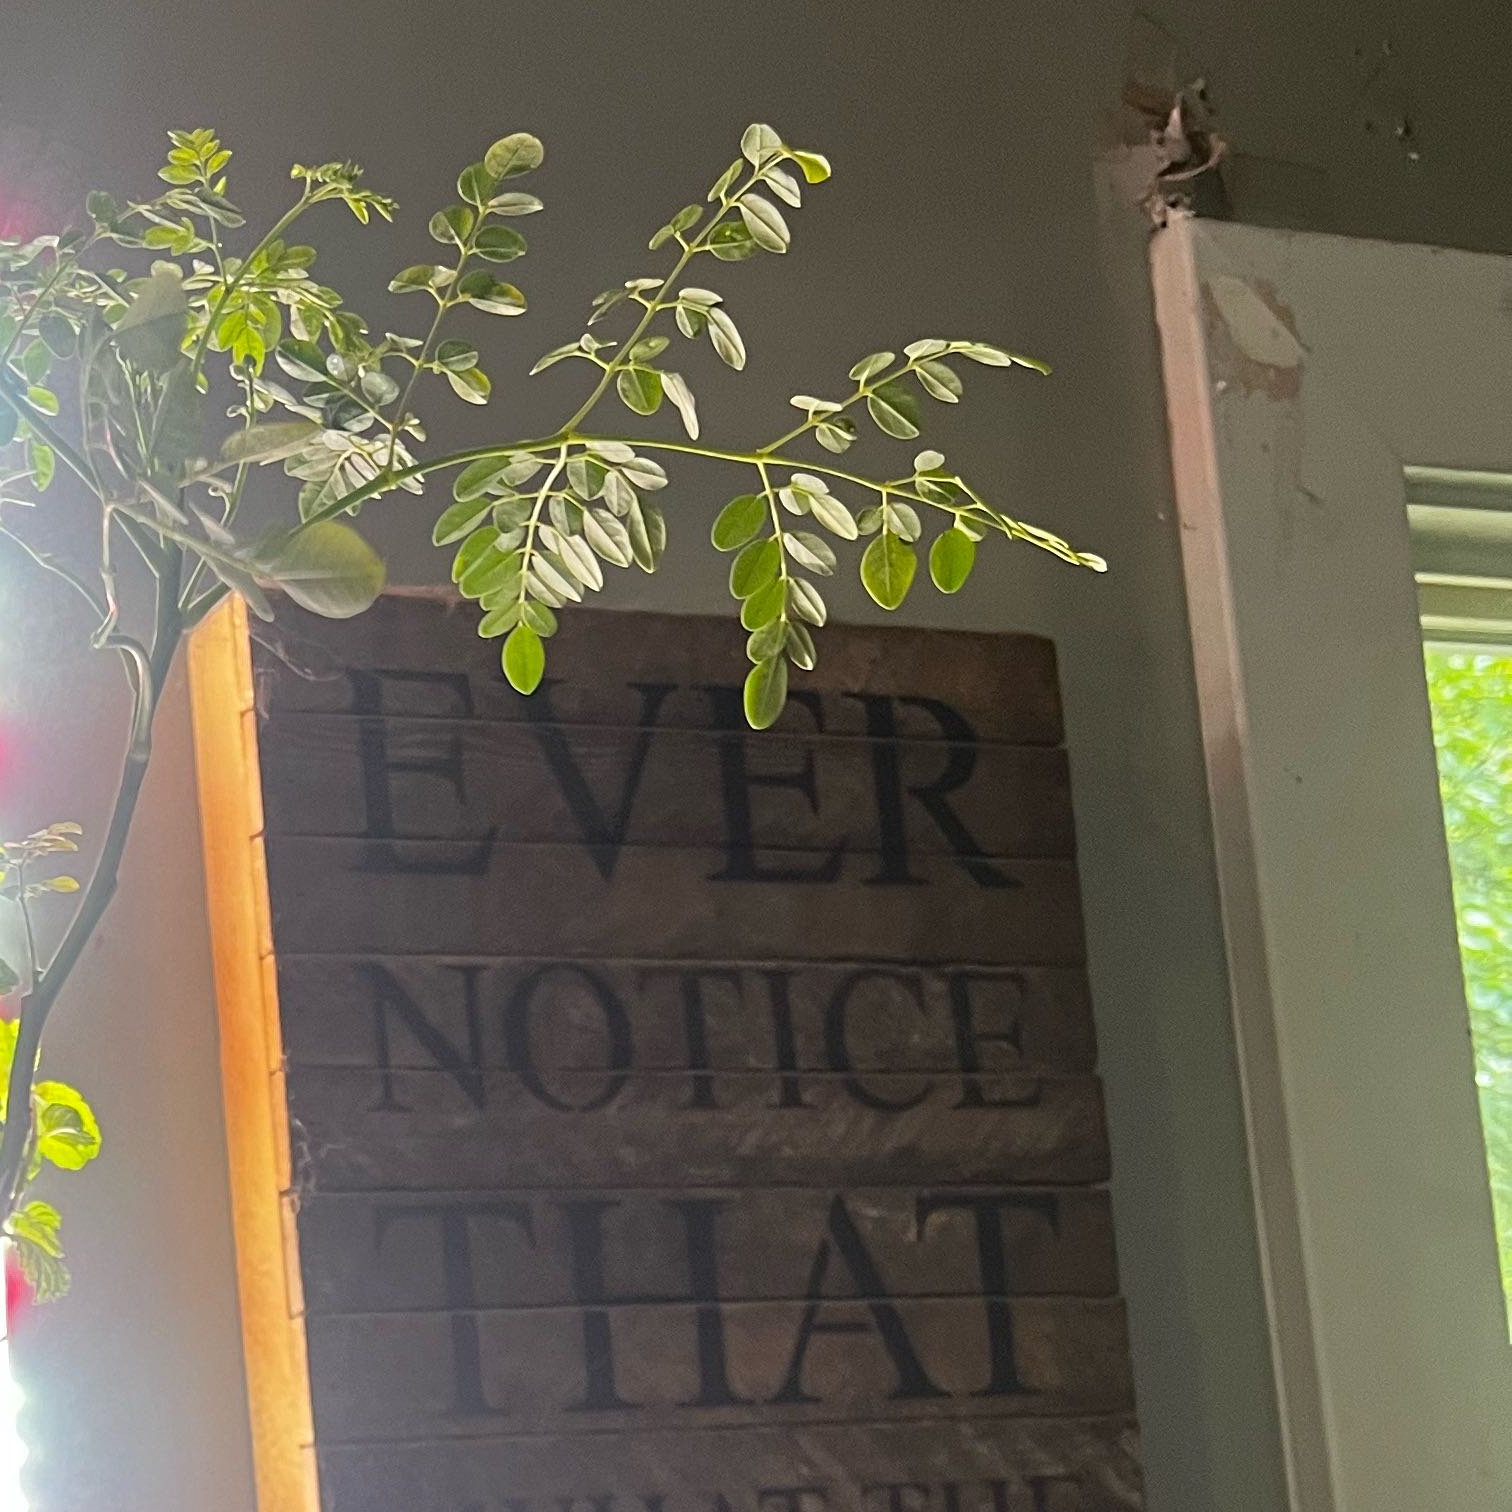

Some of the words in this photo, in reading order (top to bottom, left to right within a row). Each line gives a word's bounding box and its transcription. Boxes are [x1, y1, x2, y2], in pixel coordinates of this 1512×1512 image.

[346, 666, 1025, 890] EVER
[356, 962, 1047, 1115] NOTICE
[372, 1194, 1061, 1417] THAT
